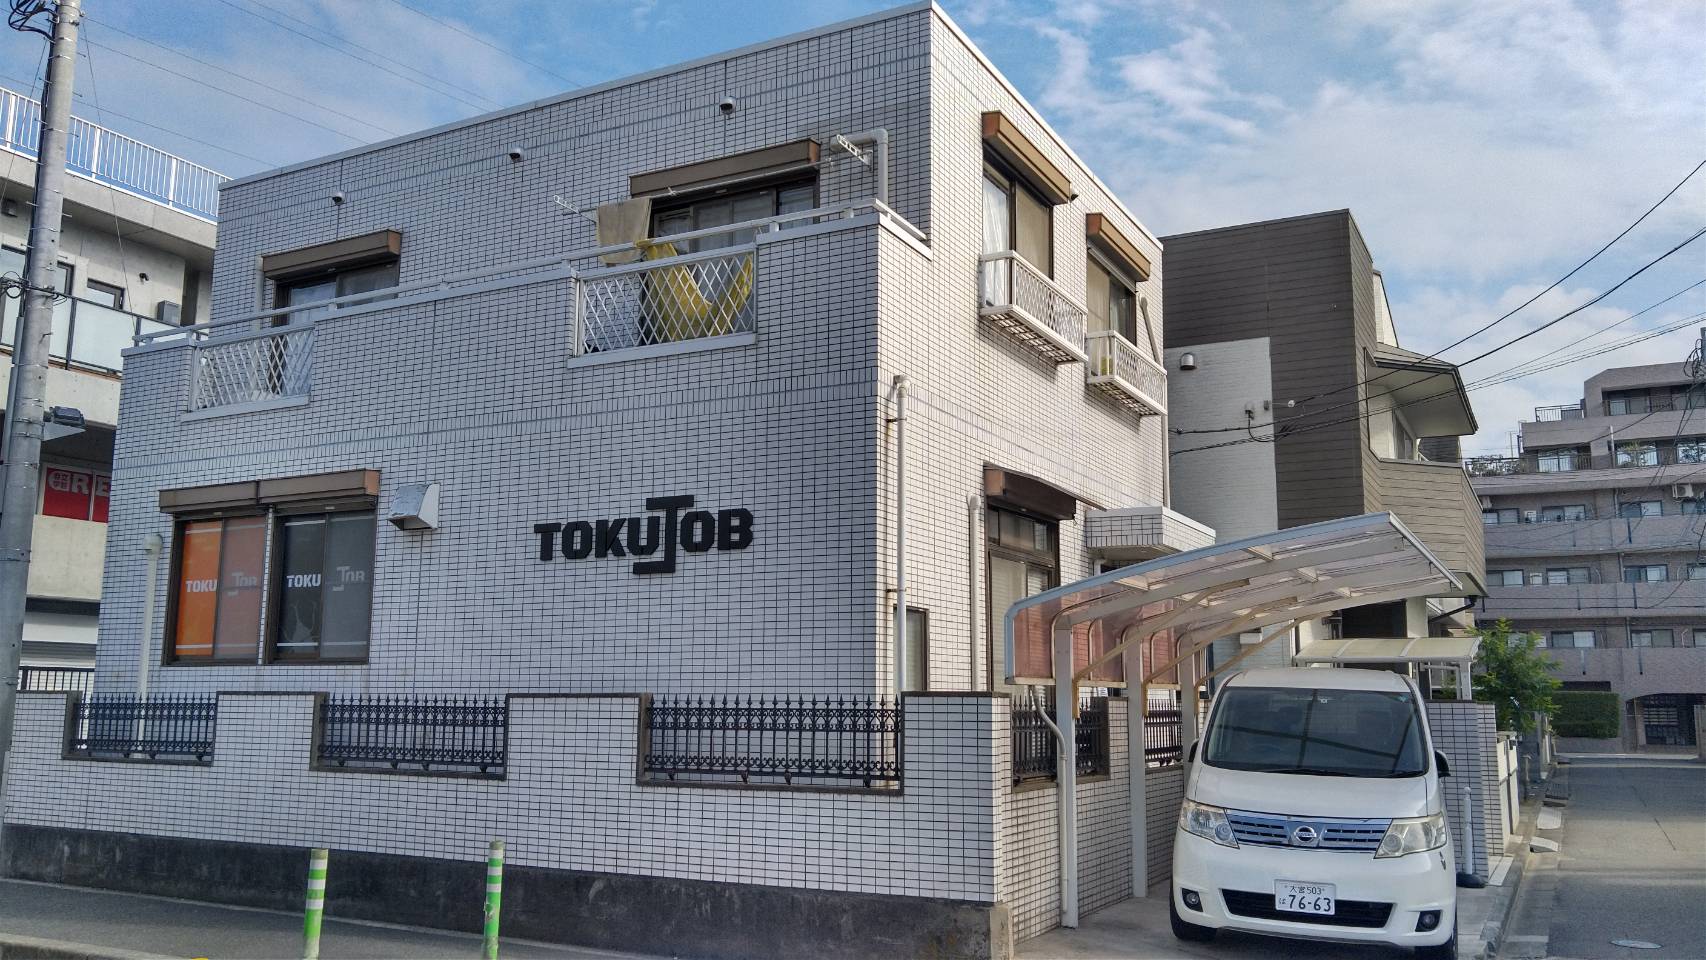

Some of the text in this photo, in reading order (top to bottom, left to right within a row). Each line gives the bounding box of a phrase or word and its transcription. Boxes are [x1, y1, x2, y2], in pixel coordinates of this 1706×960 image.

[185, 579, 218, 593] TOKU
[286, 573, 322, 588] TOKU
[1288, 895, 1331, 912] 76-63
